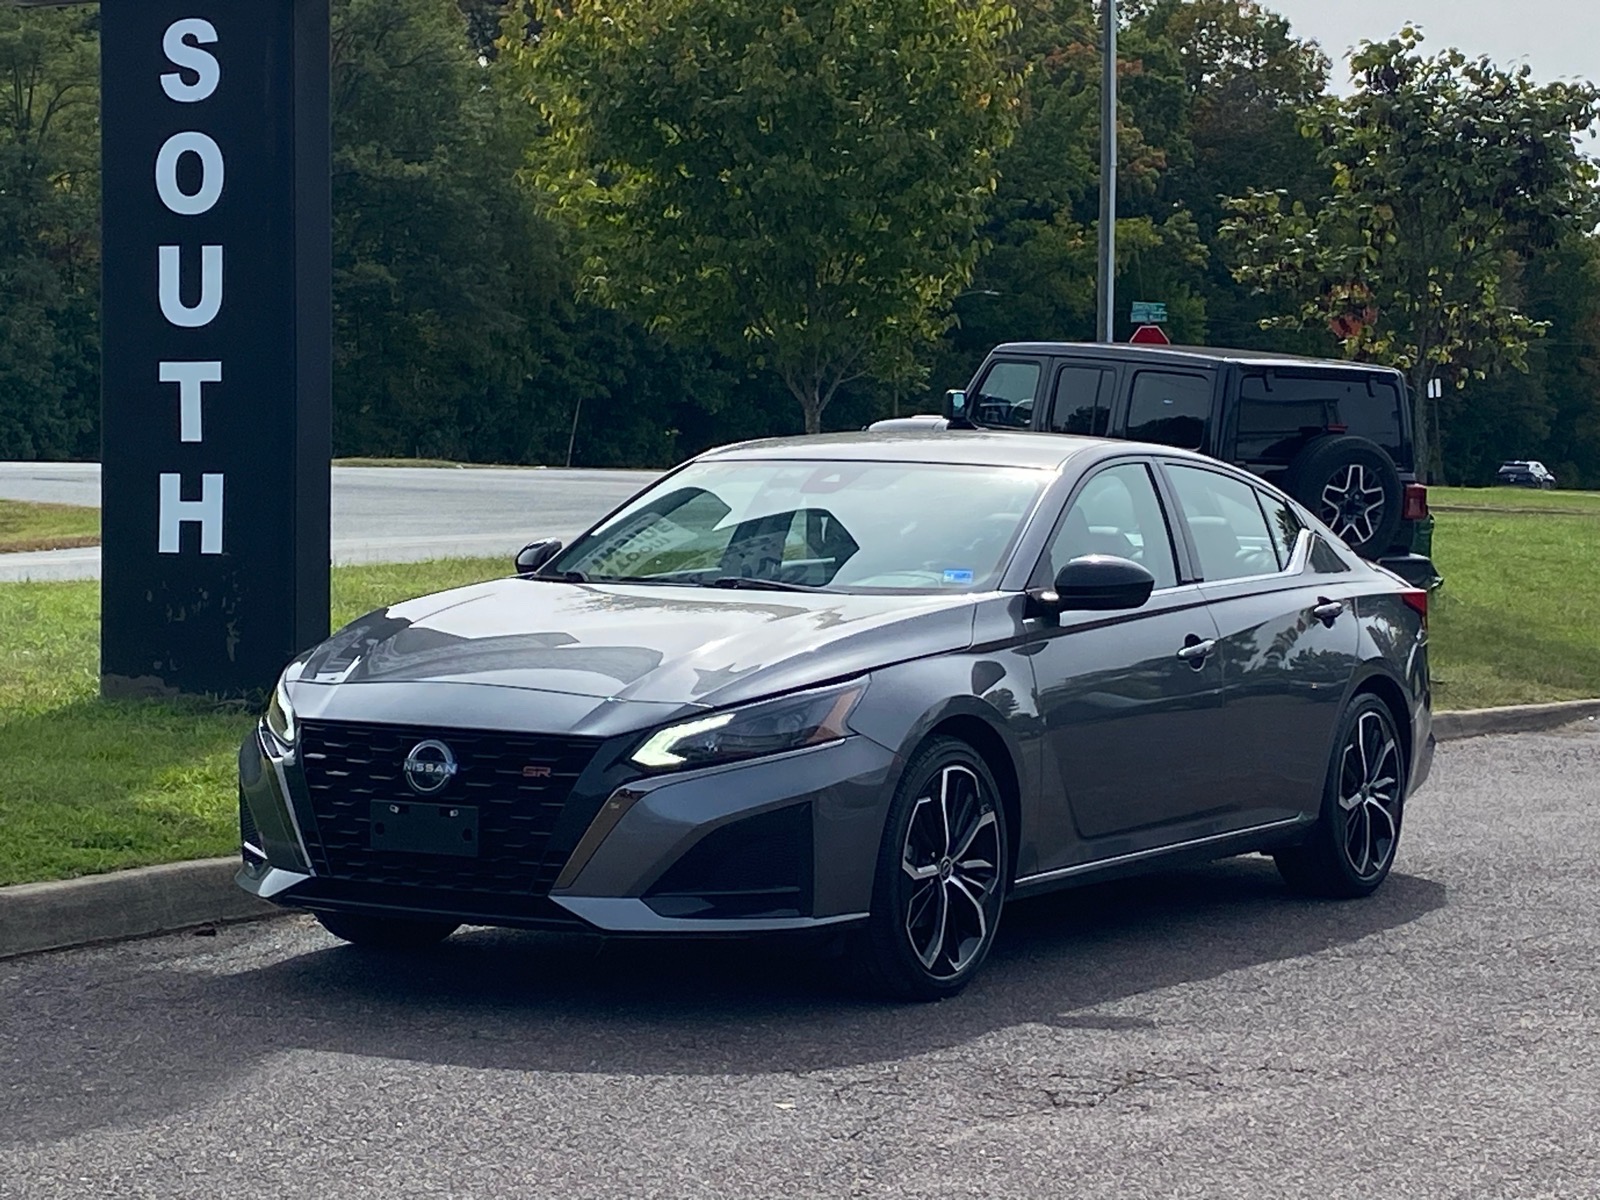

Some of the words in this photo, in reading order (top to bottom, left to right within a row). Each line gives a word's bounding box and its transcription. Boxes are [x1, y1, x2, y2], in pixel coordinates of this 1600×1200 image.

[156, 18, 224, 554] SOUTH
[402, 759, 458, 774] NISSAN
[522, 766, 551, 778] SR
